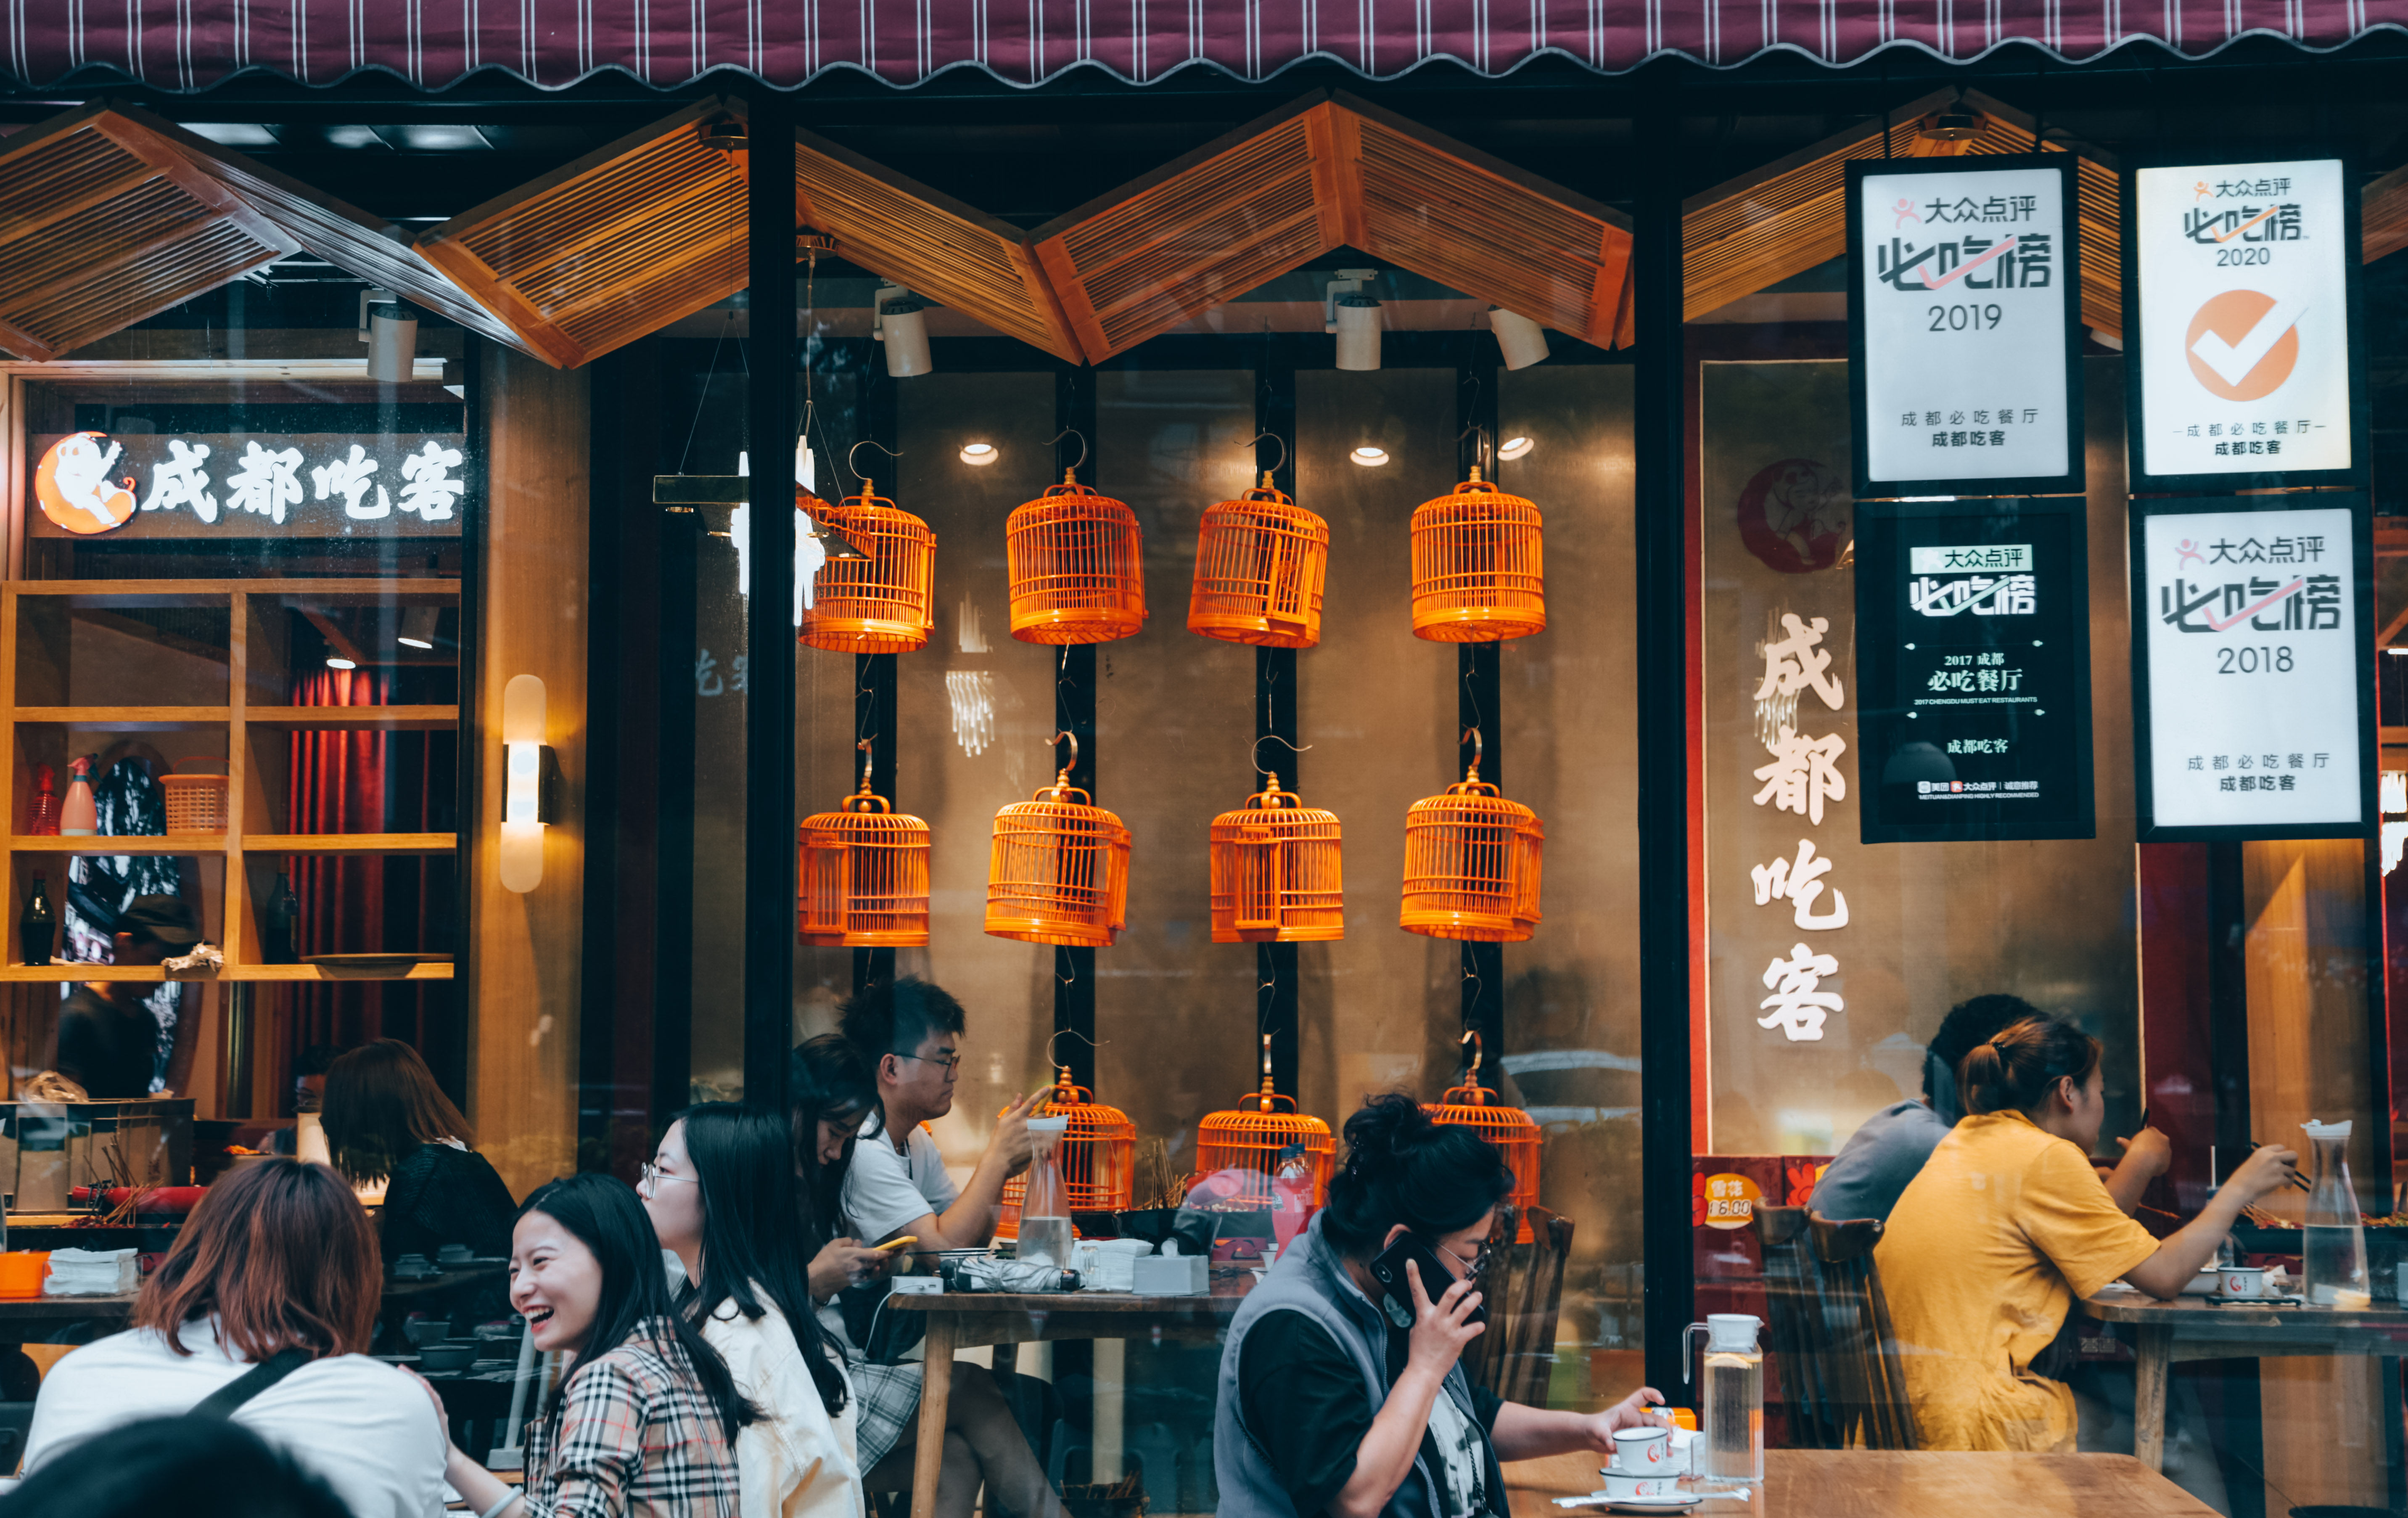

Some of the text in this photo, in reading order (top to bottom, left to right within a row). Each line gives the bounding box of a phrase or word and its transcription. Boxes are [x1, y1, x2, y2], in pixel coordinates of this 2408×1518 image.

[2216, 178, 2292, 198] 大众点评
[1924, 196, 2038, 224] 大众点评
[2184, 203, 2302, 244] 必吃榜
[1877, 233, 2052, 291] 必吃榜
[2217, 247, 2271, 267] 2020
[1928, 304, 2003, 332] 2019
[1901, 408, 2039, 427] 成都必吃餐厅
[1932, 430, 2006, 448] 成都吃客
[2186, 420, 2311, 437] 成都必吃餐厅
[2215, 440, 2281, 456] 成都吃客
[141, 439, 465, 524] 成都吃客
[1945, 548, 2024, 569] 大众点评
[2209, 536, 2326, 565] 大众点评
[1909, 574, 2036, 617] 必吃榜
[2161, 574, 2342, 634] 必吃榜
[1943, 652, 2005, 666] 2017 成都
[2217, 646, 2294, 674] 2018
[1927, 668, 2023, 692] 必吃餐厅
[1947, 738, 2008, 754] 成都吃客
[2188, 753, 2330, 772] 成都必吃餐厅
[1963, 782, 1997, 791] 大众点评
[2220, 775, 2296, 792] 成都吃客
[1751, 613, 1849, 1041] 成都吃客
